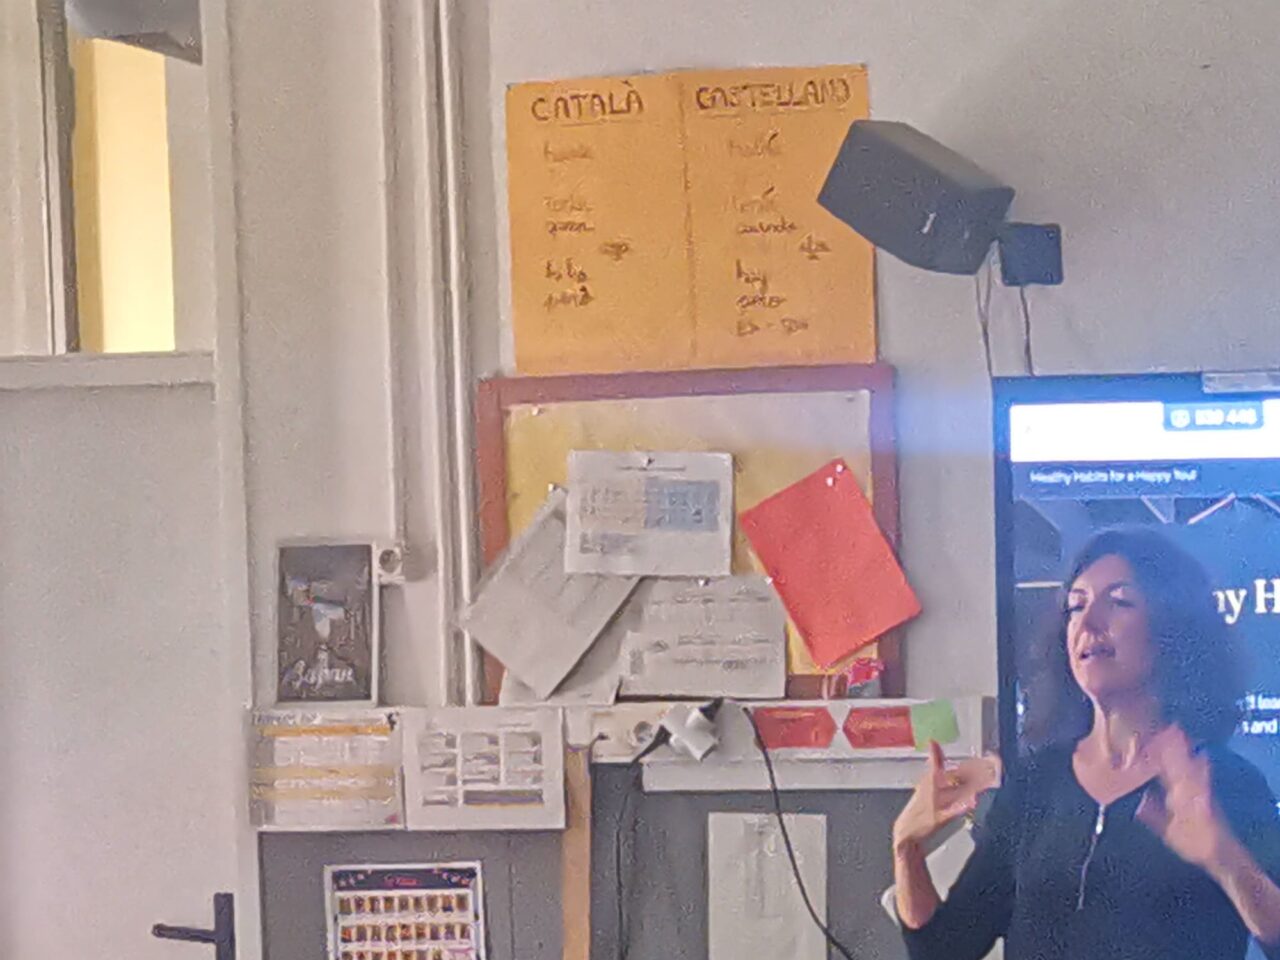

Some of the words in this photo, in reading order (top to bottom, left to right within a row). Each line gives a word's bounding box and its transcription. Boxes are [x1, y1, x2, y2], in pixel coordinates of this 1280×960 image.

[531, 80, 644, 121] CATALÀ
[695, 76, 852, 111] CASTELLANO
[1250, 719, 1278, 734] and
